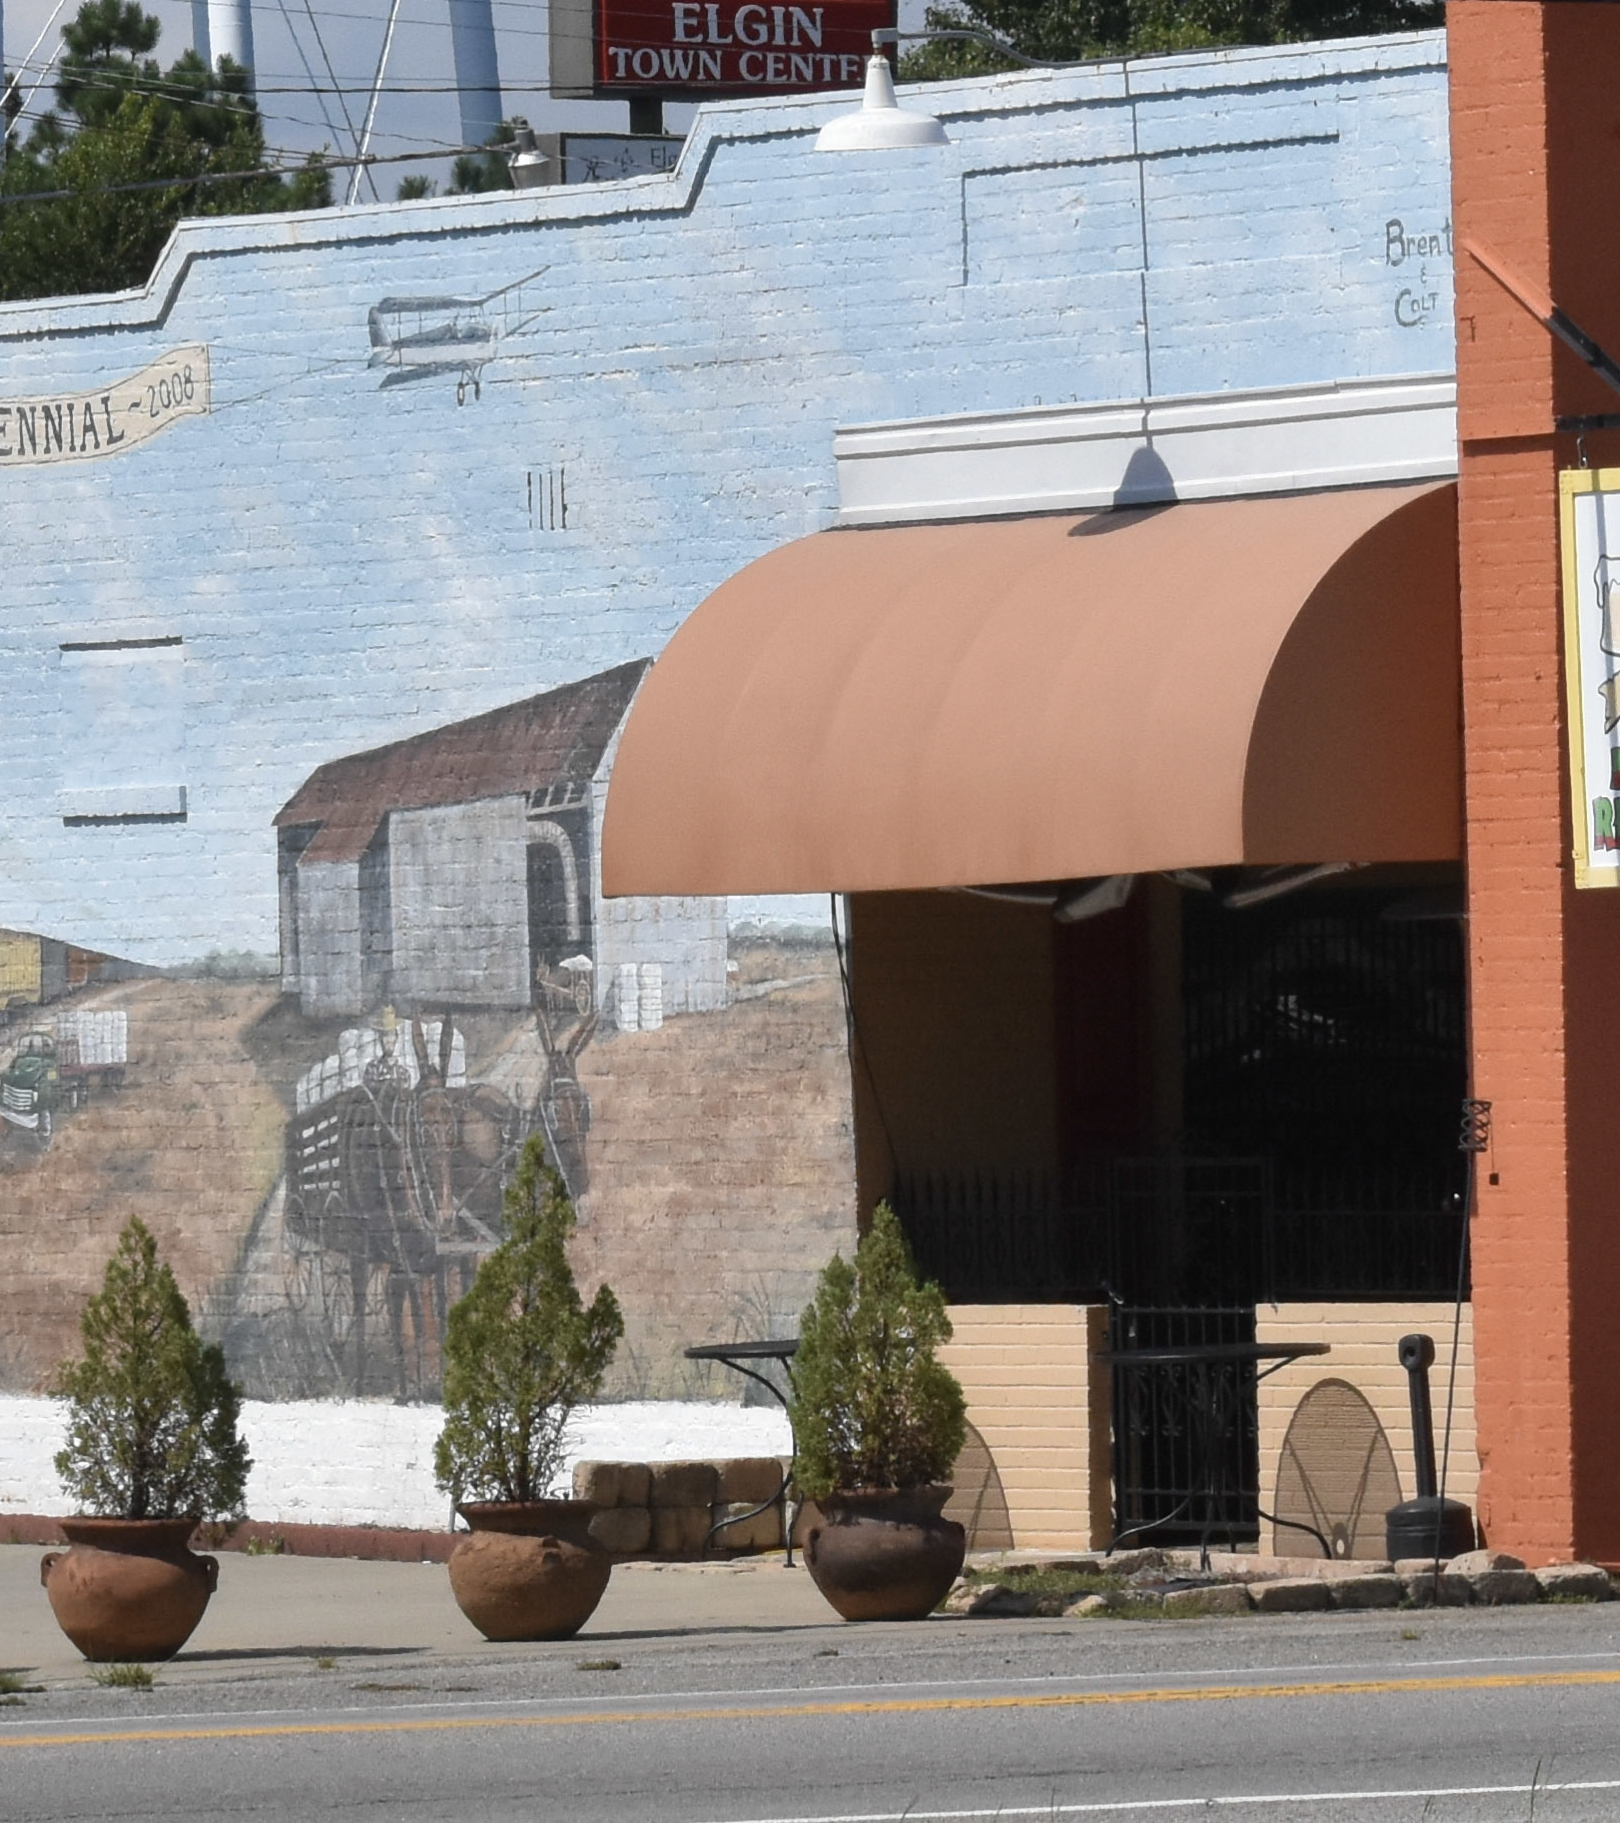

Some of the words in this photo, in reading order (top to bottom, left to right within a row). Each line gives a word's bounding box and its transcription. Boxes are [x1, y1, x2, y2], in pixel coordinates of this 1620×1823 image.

[672, 2, 824, 47] ELGIN
[608, 46, 722, 80] TOWN
[739, 52, 868, 82] CENTE
[1385, 217, 1454, 266] Brent
